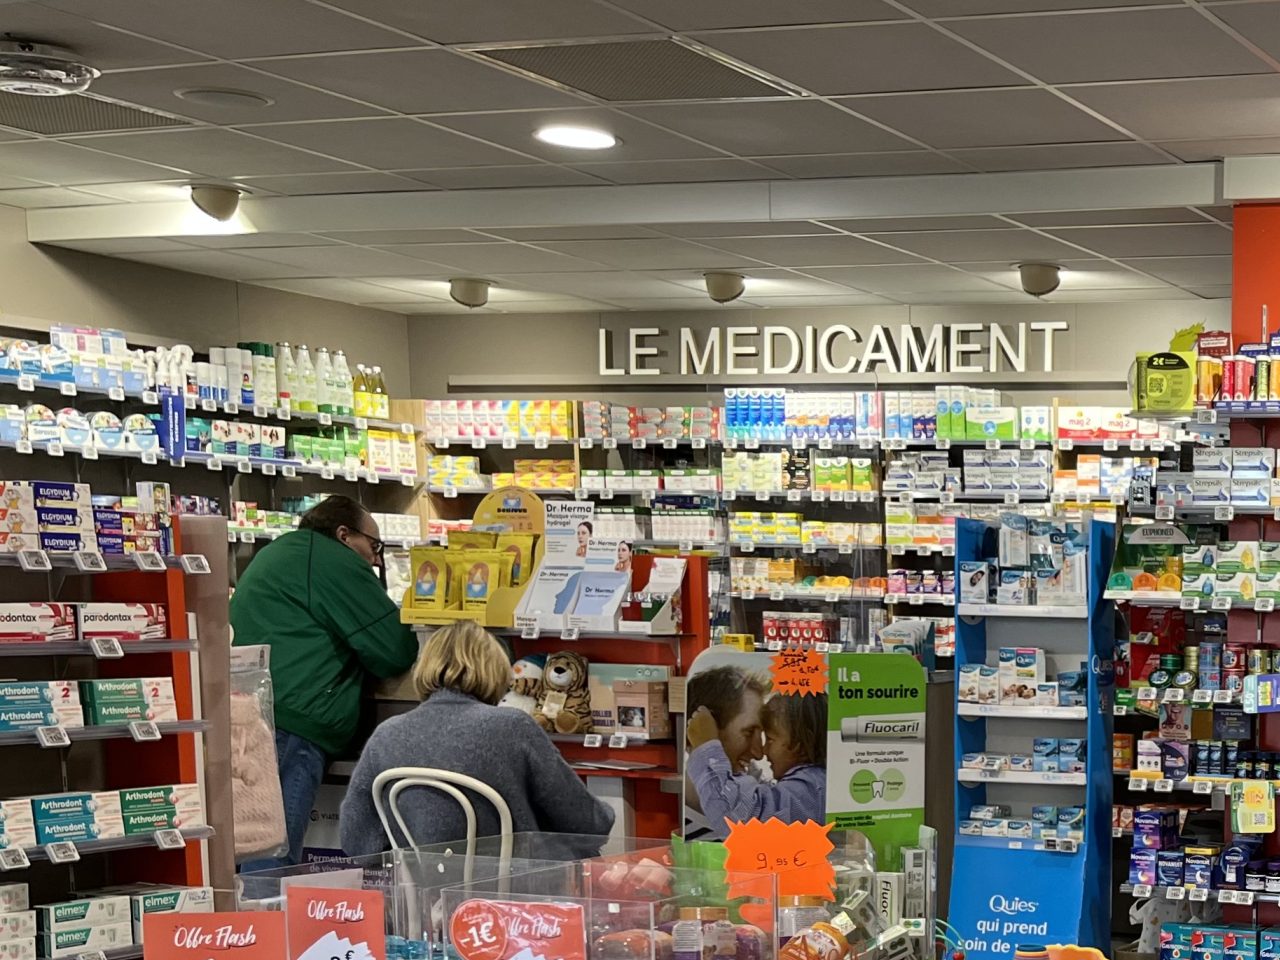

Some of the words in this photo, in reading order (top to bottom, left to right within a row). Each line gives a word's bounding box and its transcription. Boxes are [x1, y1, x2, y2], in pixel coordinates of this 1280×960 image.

[599, 327, 660, 375] LE
[680, 321, 1068, 375] MEDICAMENT
[1194, 449, 1223, 459] Strepsils
[39, 487, 70, 497] ELGYDIUM
[546, 503, 558, 513] Dr
[560, 504, 592, 514] Herma
[41, 513, 72, 522] ELGYDIUM
[83, 613, 132, 623] parodontax
[98, 683, 138, 691] Arthrodont
[838, 685, 863, 700] ton
[867, 685, 919, 699] sourire
[1, 711, 44, 721] Arthrodont
[864, 721, 919, 733] Fluocaril
[126, 790, 165, 801] Arthrodont
[41, 799, 83, 811] Arthrodont
[793, 850, 808, 866] €
[989, 894, 1036, 915] Quies
[56, 906, 85, 917] elmex
[335, 901, 364, 921] Flash
[977, 918, 999, 934] qui
[1003, 921, 1048, 936] prend
[57, 932, 86, 944] elmex
[174, 927, 213, 949] Offre
[215, 925, 257, 947] Flash
[991, 939, 1011, 953] de
